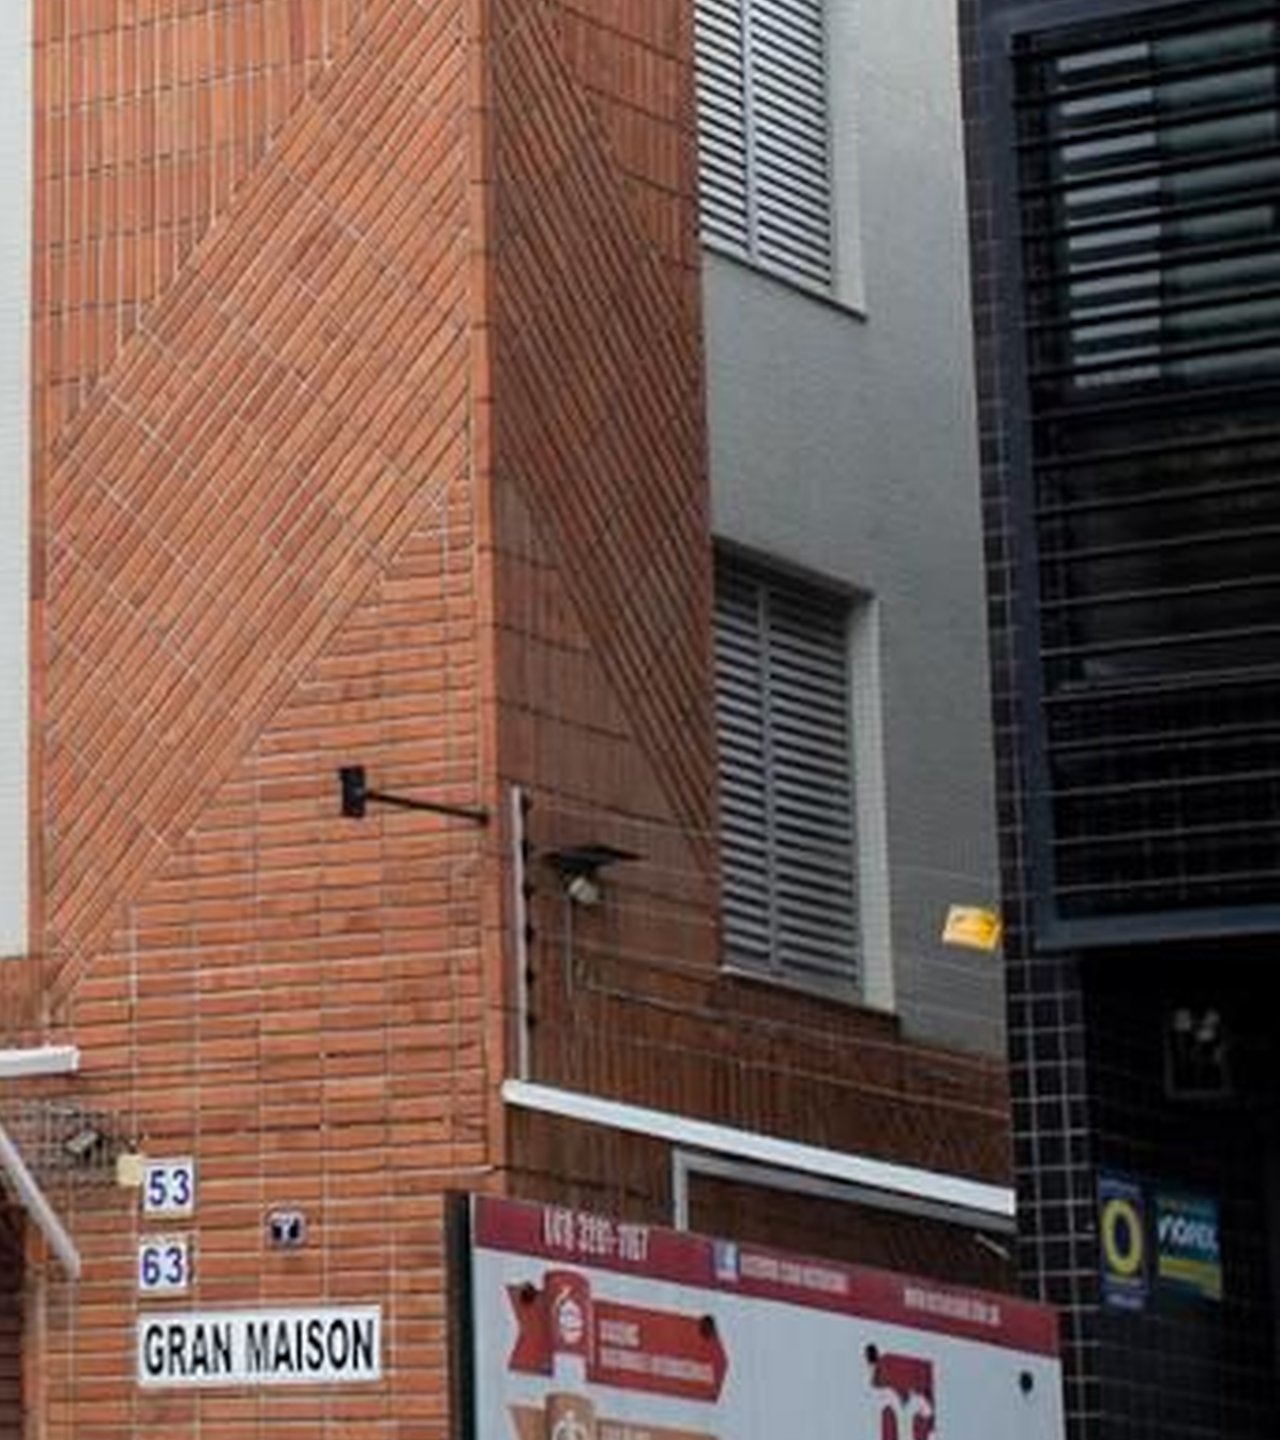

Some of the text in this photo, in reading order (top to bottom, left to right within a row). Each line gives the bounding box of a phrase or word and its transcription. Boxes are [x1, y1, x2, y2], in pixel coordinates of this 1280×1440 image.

[149, 1169, 191, 1206] 53
[142, 1247, 184, 1285] 63
[144, 1318, 373, 1375] GRAN MAISON
